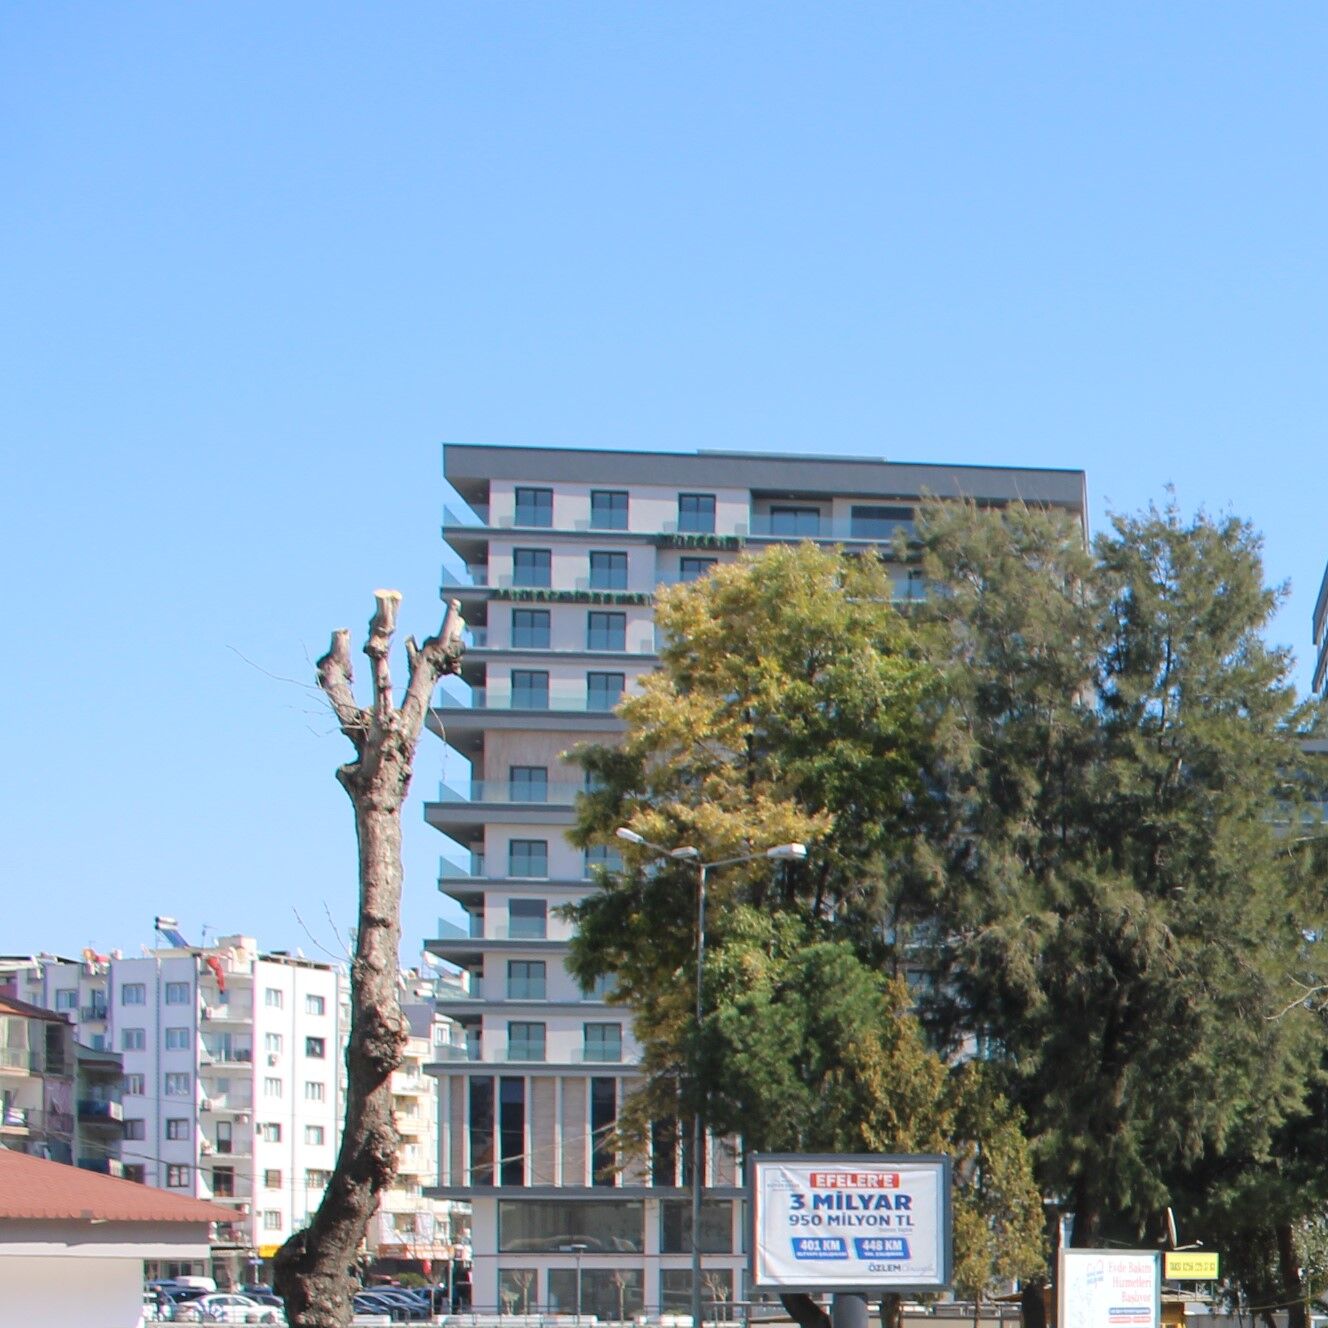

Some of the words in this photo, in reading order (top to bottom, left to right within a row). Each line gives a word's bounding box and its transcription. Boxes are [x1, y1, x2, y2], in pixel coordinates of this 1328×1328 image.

[815, 1174, 894, 1188] EFELER'E
[790, 1194, 805, 1210] 3
[812, 1191, 913, 1210] MİLYAR
[789, 1214, 822, 1227] 950
[827, 1212, 891, 1227] MİLYON
[896, 1214, 915, 1227] TL
[800, 1240, 820, 1251] 401
[823, 1240, 840, 1251] KM
[885, 1240, 903, 1251] KM
[868, 1262, 902, 1272] ÖZLEM
